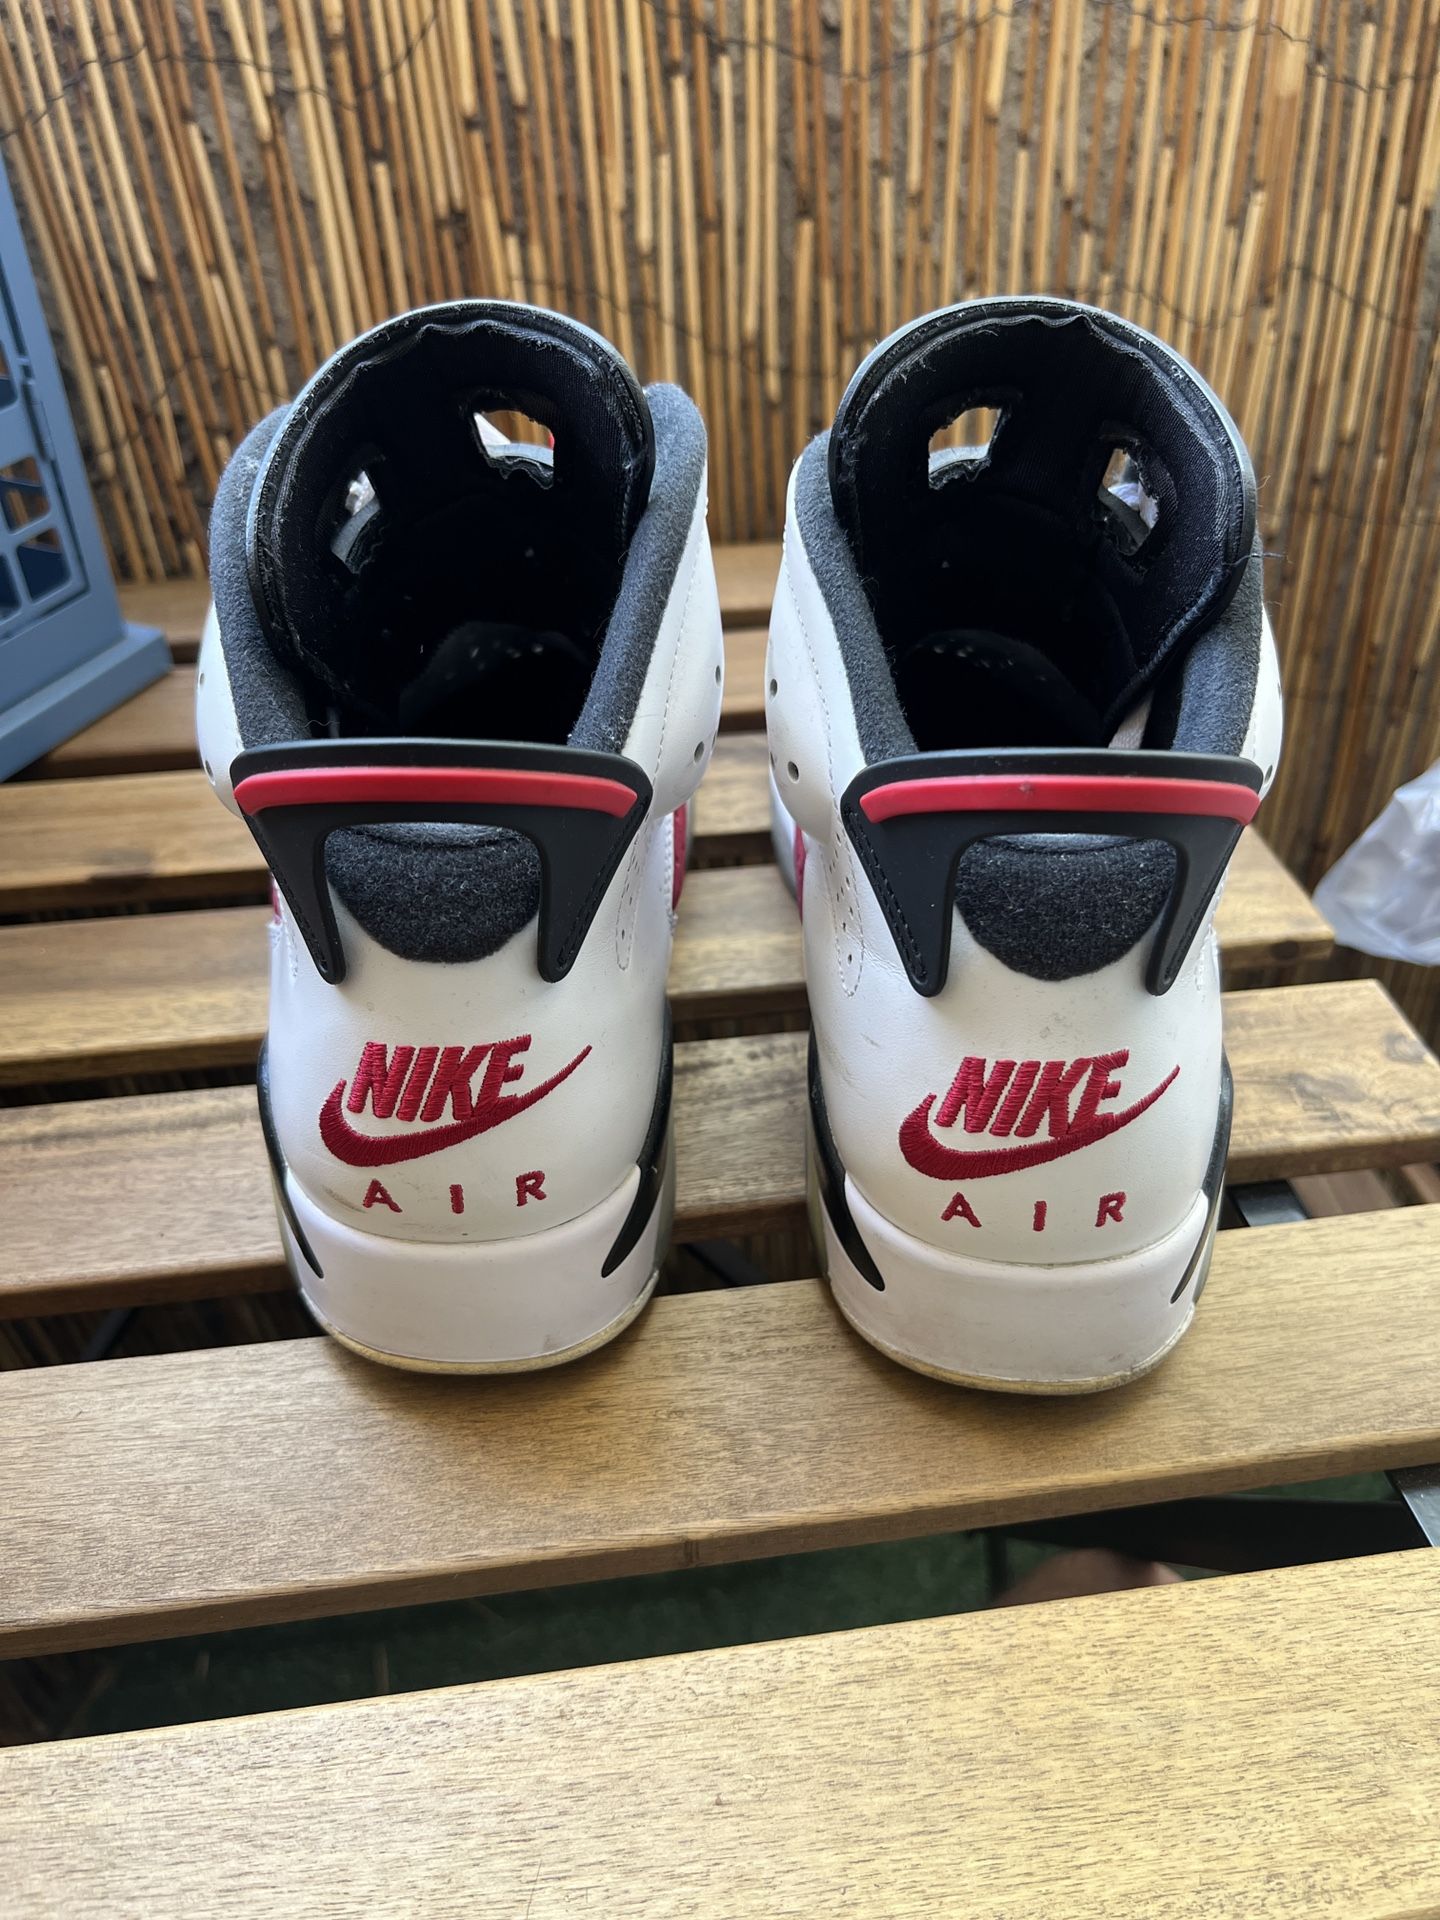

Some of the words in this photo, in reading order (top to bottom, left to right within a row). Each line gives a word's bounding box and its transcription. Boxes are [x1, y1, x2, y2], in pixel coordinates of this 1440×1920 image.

[347, 1034, 532, 1122] NIKE
[934, 1048, 1130, 1138] NIKE
[362, 1171, 548, 1214] AIR
[940, 1191, 1127, 1232] AIR
